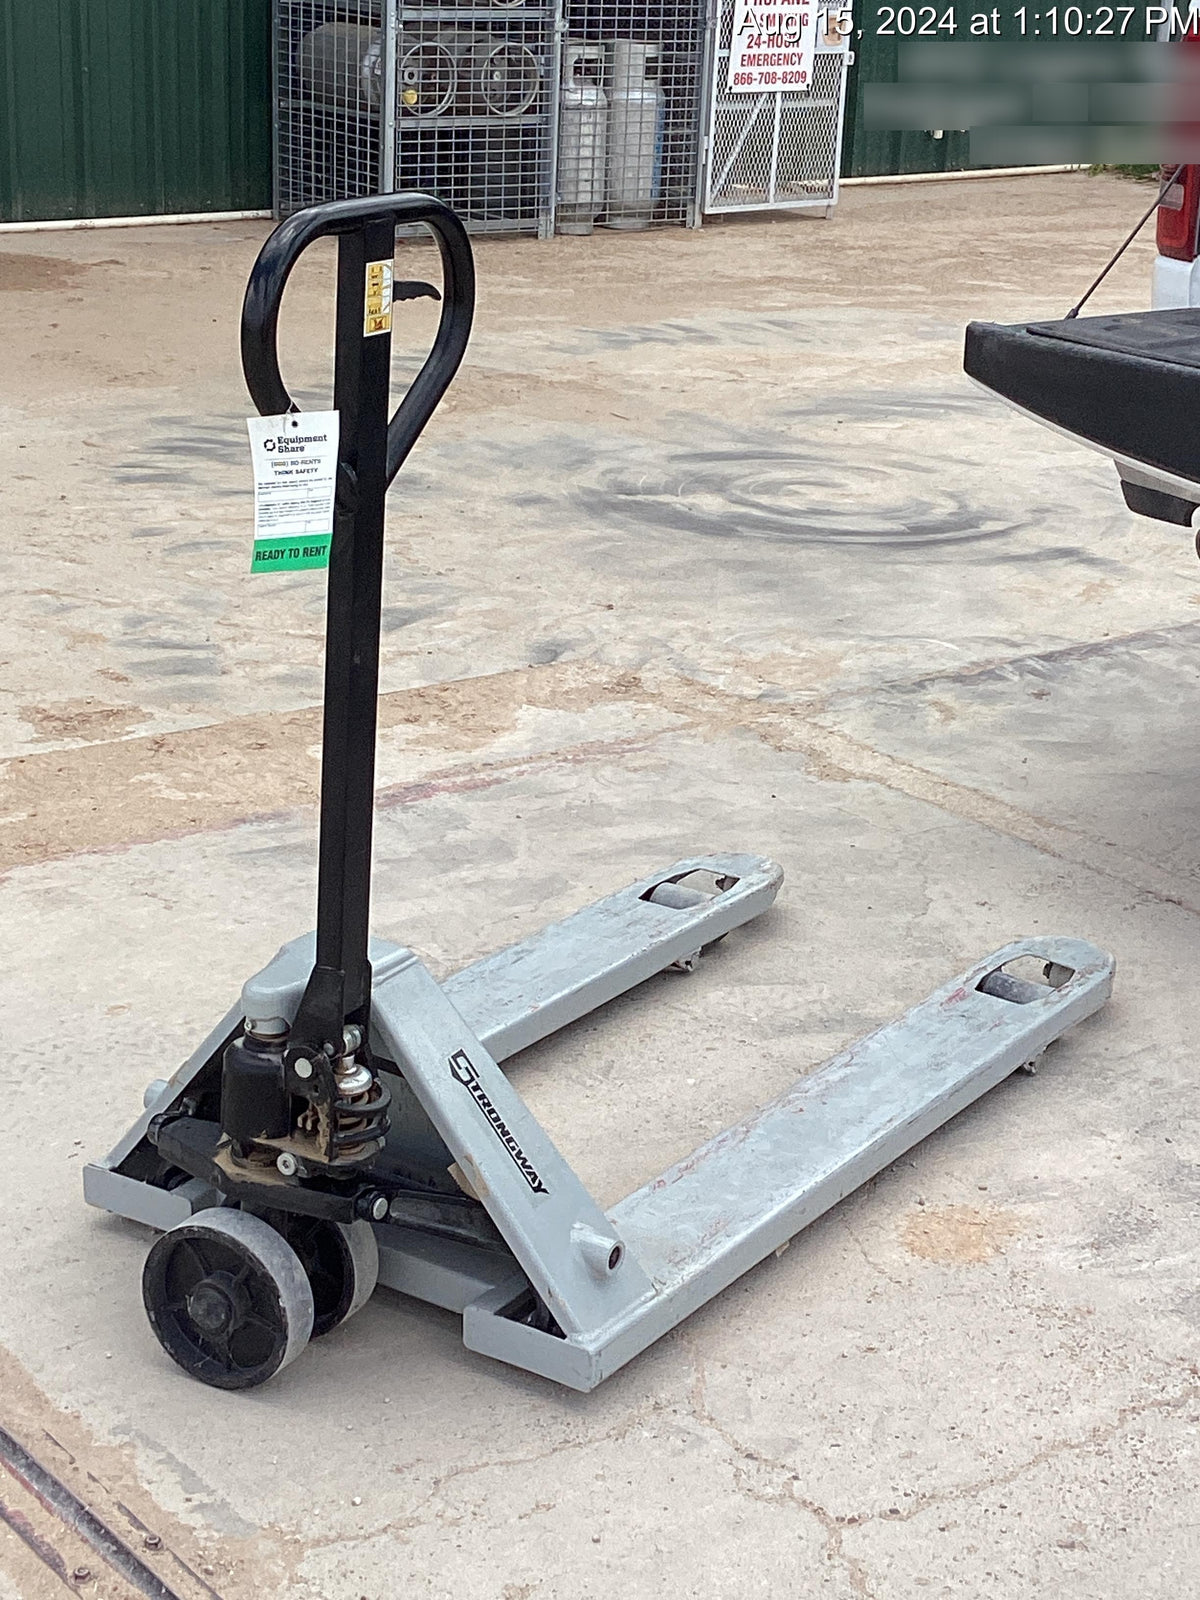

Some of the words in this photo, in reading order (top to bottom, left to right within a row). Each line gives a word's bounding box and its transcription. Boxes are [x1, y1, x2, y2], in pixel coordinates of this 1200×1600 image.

[740, 53, 803, 67] EMERGENCY
[733, 71, 807, 85] 866-708-8209
[277, 434, 327, 445] Equipment
[278, 445, 305, 453] Share
[255, 548, 286, 561] READY
[288, 547, 300, 559] TO
[303, 545, 327, 557] RENT
[448, 1048, 550, 1195] STRONGWAY
